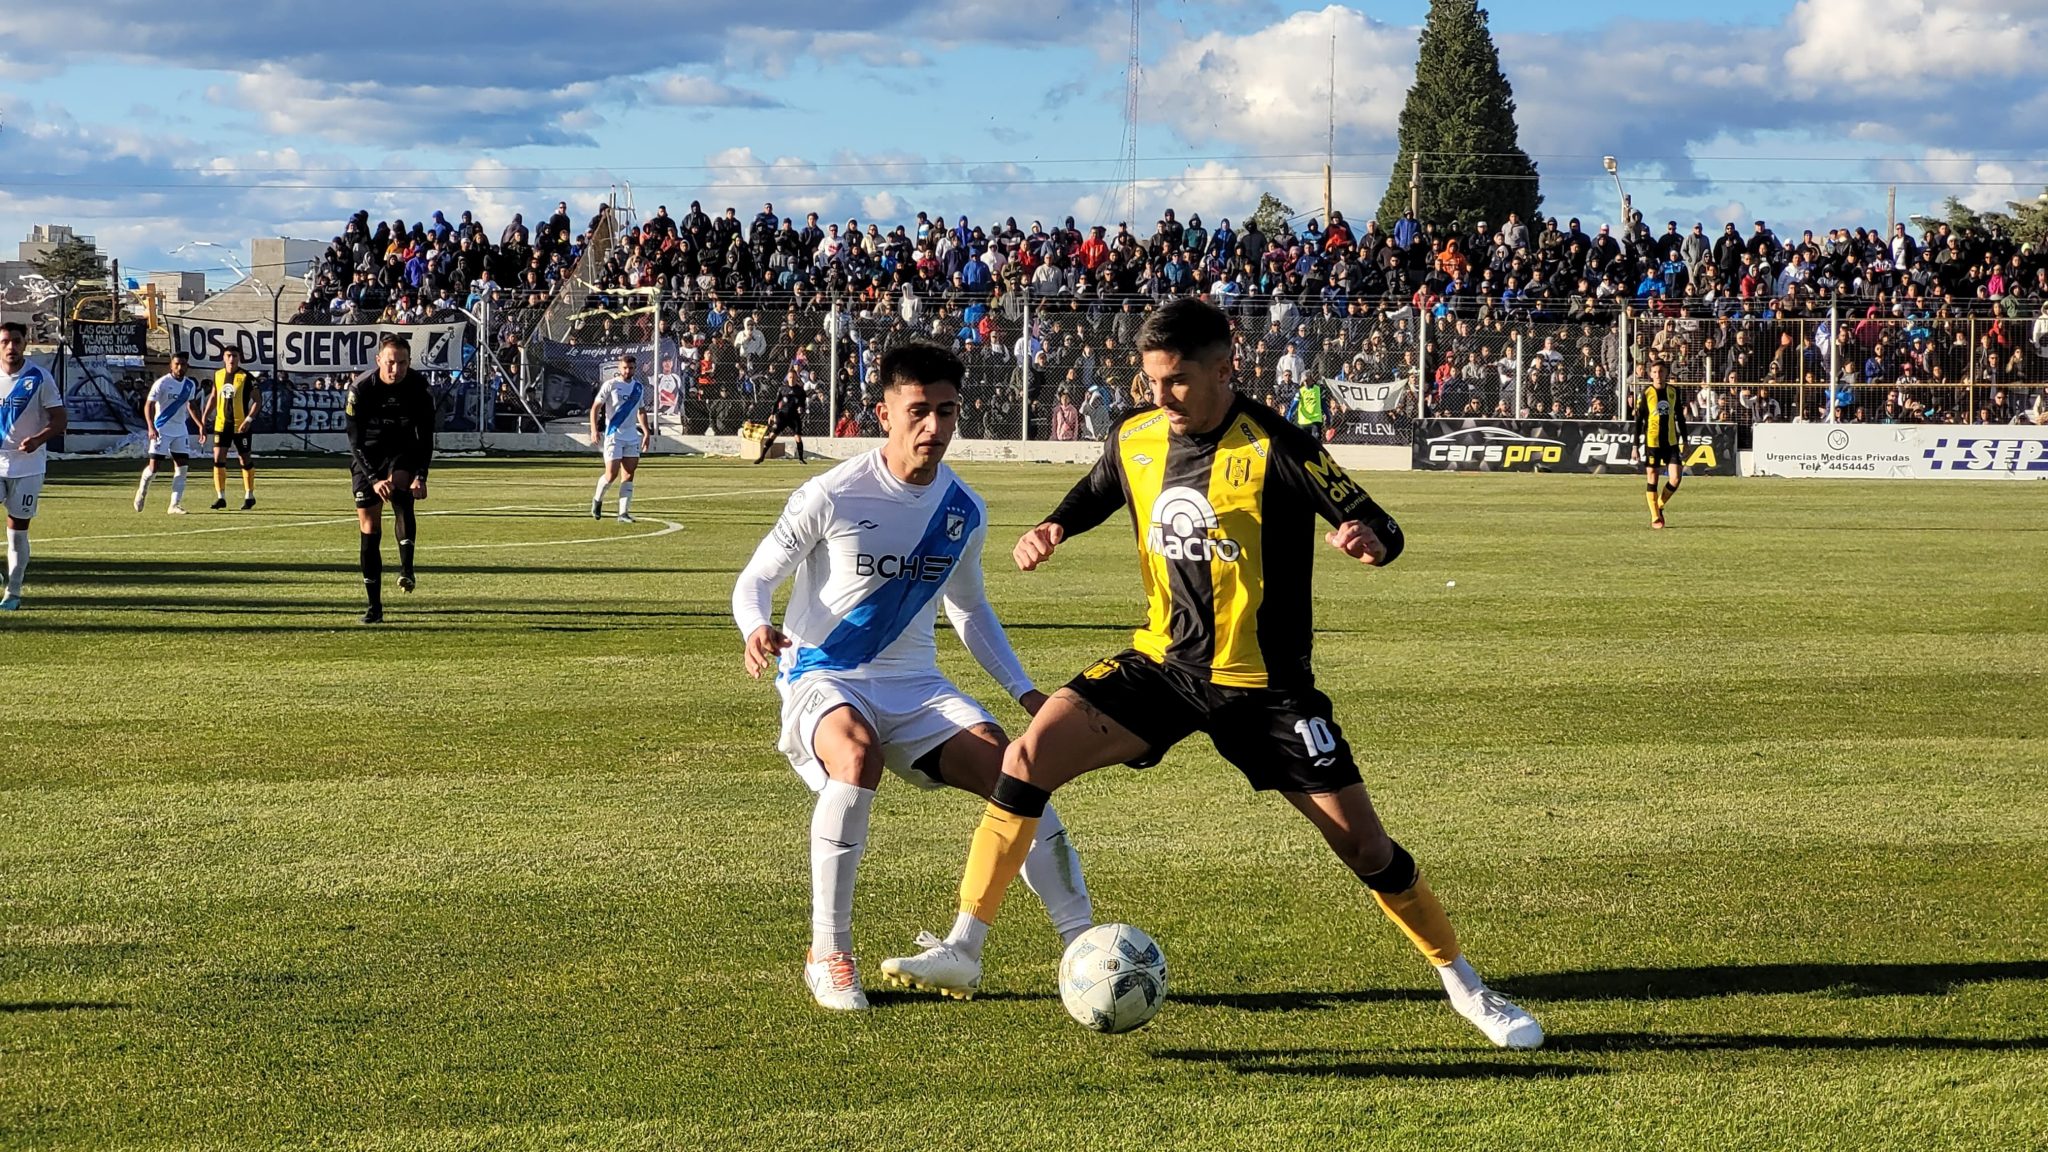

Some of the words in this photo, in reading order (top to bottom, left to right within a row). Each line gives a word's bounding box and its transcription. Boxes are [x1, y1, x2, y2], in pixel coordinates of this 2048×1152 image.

[79, 324, 94, 335] LAS
[96, 324, 119, 335] COSAS
[121, 325, 136, 334] QUE
[172, 323, 225, 362] LOS
[236, 330, 275, 364] DE
[285, 331, 413, 366] SIEMP
[1337, 384, 1390, 401] POLO
[1345, 422, 1396, 436] TRELEW
[1766, 453, 1817, 463] Urgencias
[1820, 453, 1863, 462] Medicas
[1866, 454, 1910, 462] Privadas
[1966, 440, 2043, 470] SEP
[1829, 463, 1875, 471] 4454445
[22, 494, 33, 506] 10
[1294, 716, 1336, 758] 10
